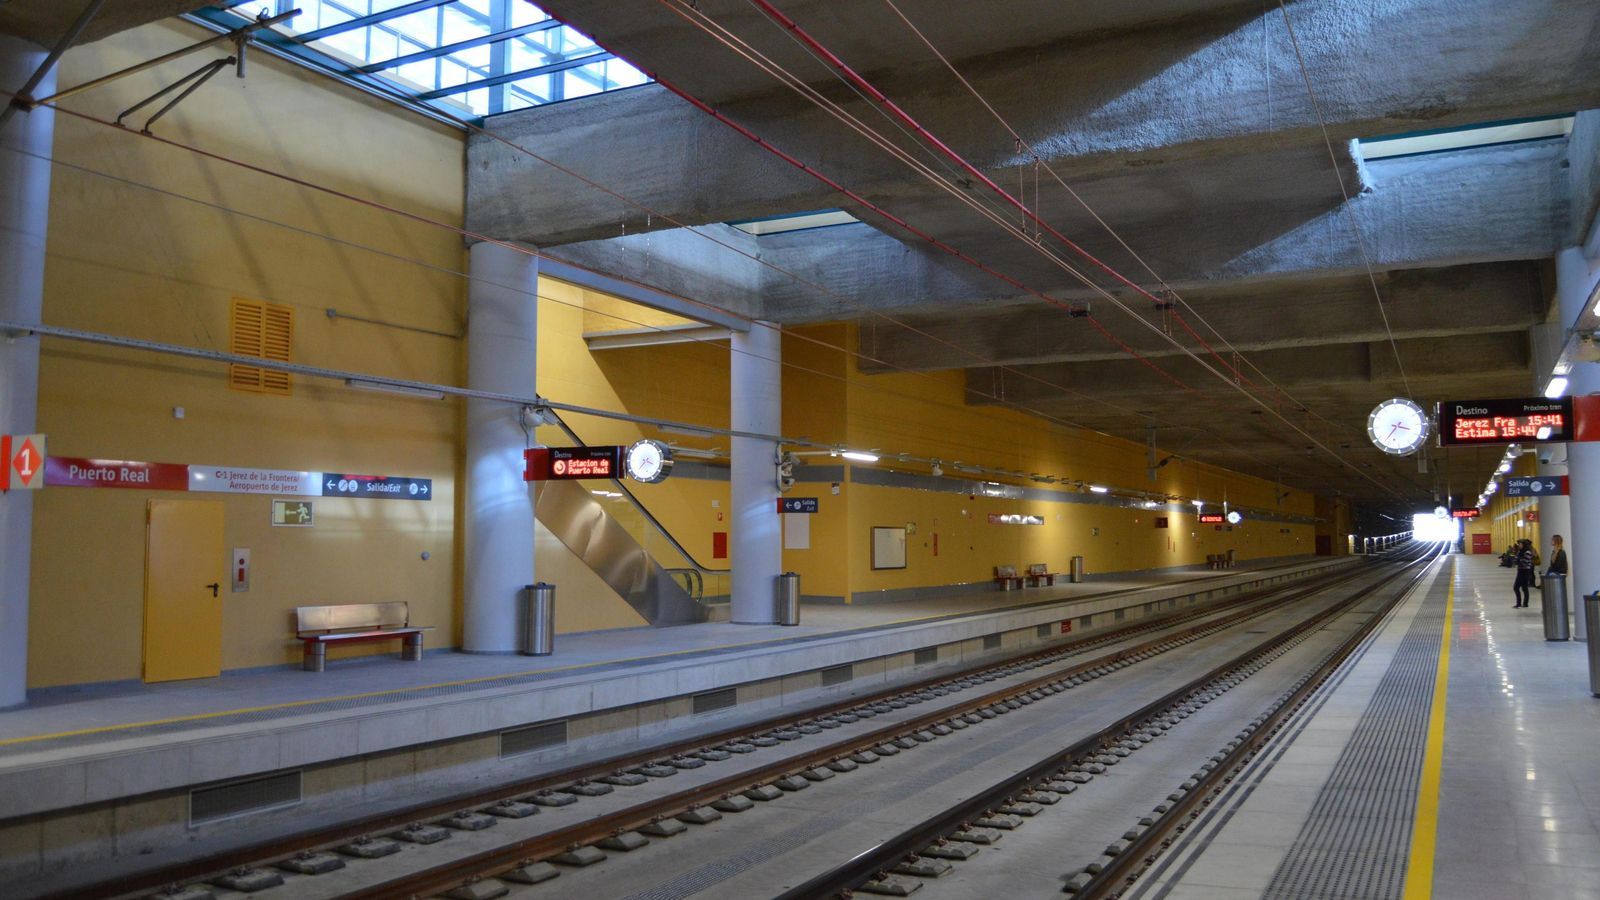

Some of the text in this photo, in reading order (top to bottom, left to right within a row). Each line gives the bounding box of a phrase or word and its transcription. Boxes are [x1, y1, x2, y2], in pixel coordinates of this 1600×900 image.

[1456, 405, 1488, 415] Destino
[1455, 414, 1563, 428] Jerez Fra 15:41
[1455, 426, 1536, 439] Estima 15:44
[20, 448, 32, 476] 1
[600, 459, 609, 467] de
[69, 464, 150, 483] Puerto Real
[229, 471, 248, 480] Jerez
[249, 472, 258, 480] de
[269, 473, 298, 482] Frontera
[229, 481, 298, 492] Aeropuerto de Jerez
[366, 482, 401, 493] Salida/Exit
[1508, 480, 1530, 488] Salida
